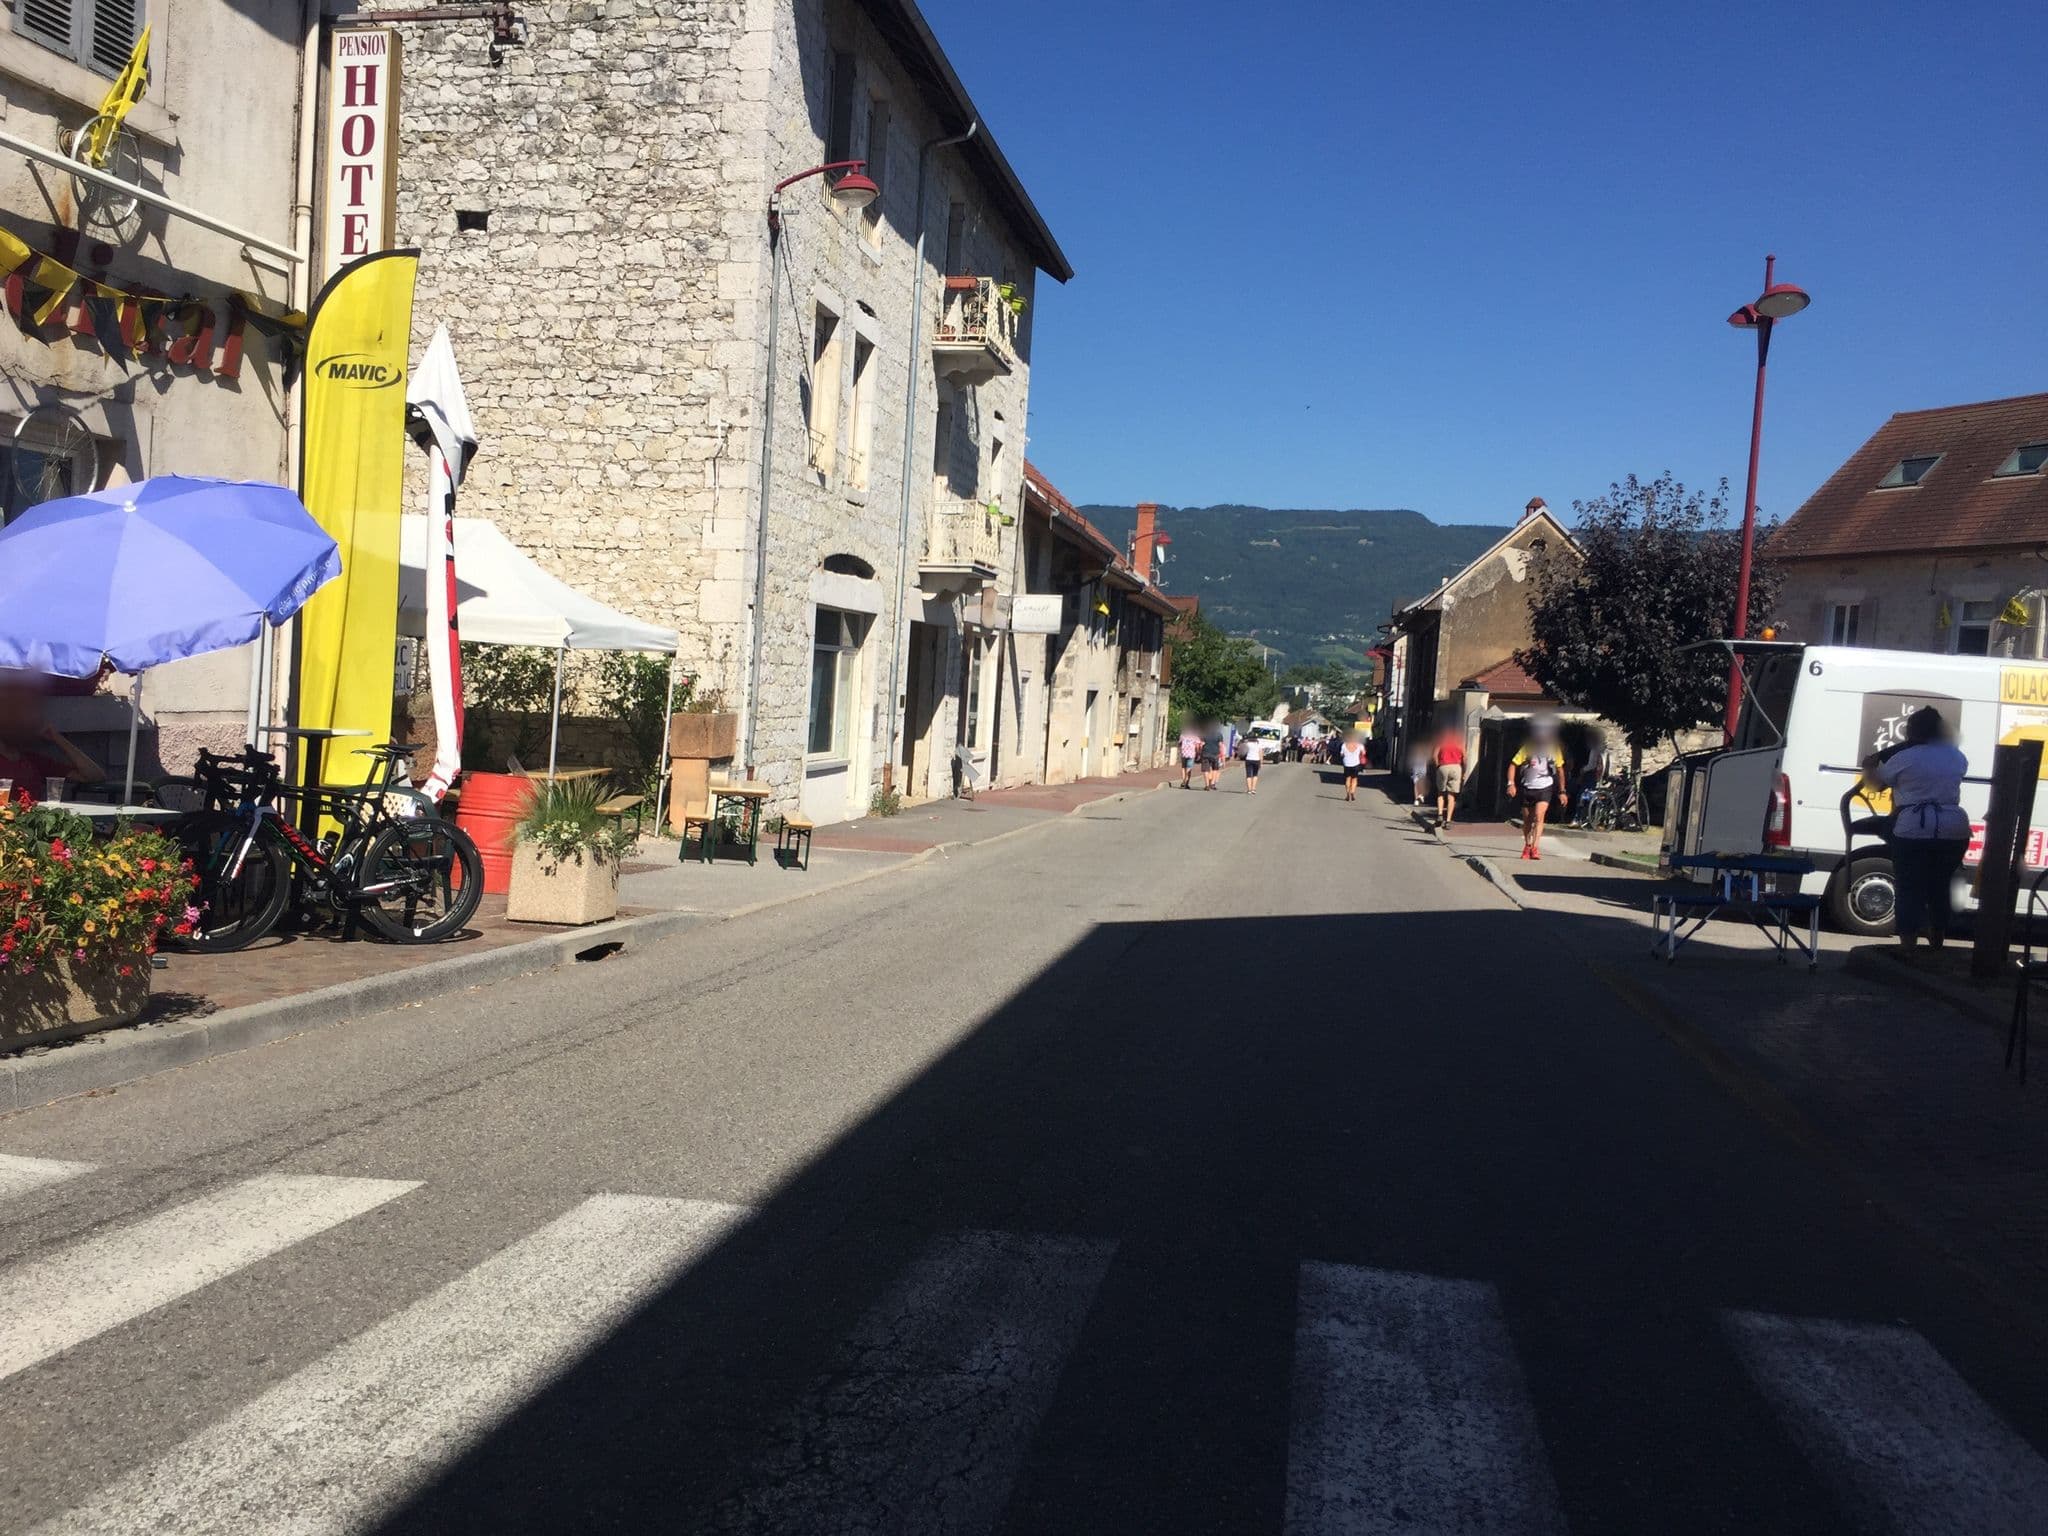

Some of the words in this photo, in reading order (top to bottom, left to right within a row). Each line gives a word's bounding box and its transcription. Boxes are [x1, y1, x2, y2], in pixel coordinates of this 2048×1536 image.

[338, 34, 387, 57] PENSION
[340, 64, 380, 268] HOTE
[328, 363, 387, 383] MAVIC
[1808, 660, 1823, 677] 6
[2003, 671, 2018, 700] ICI
[2021, 673, 2038, 702] LA
[1901, 702, 1915, 717] le
